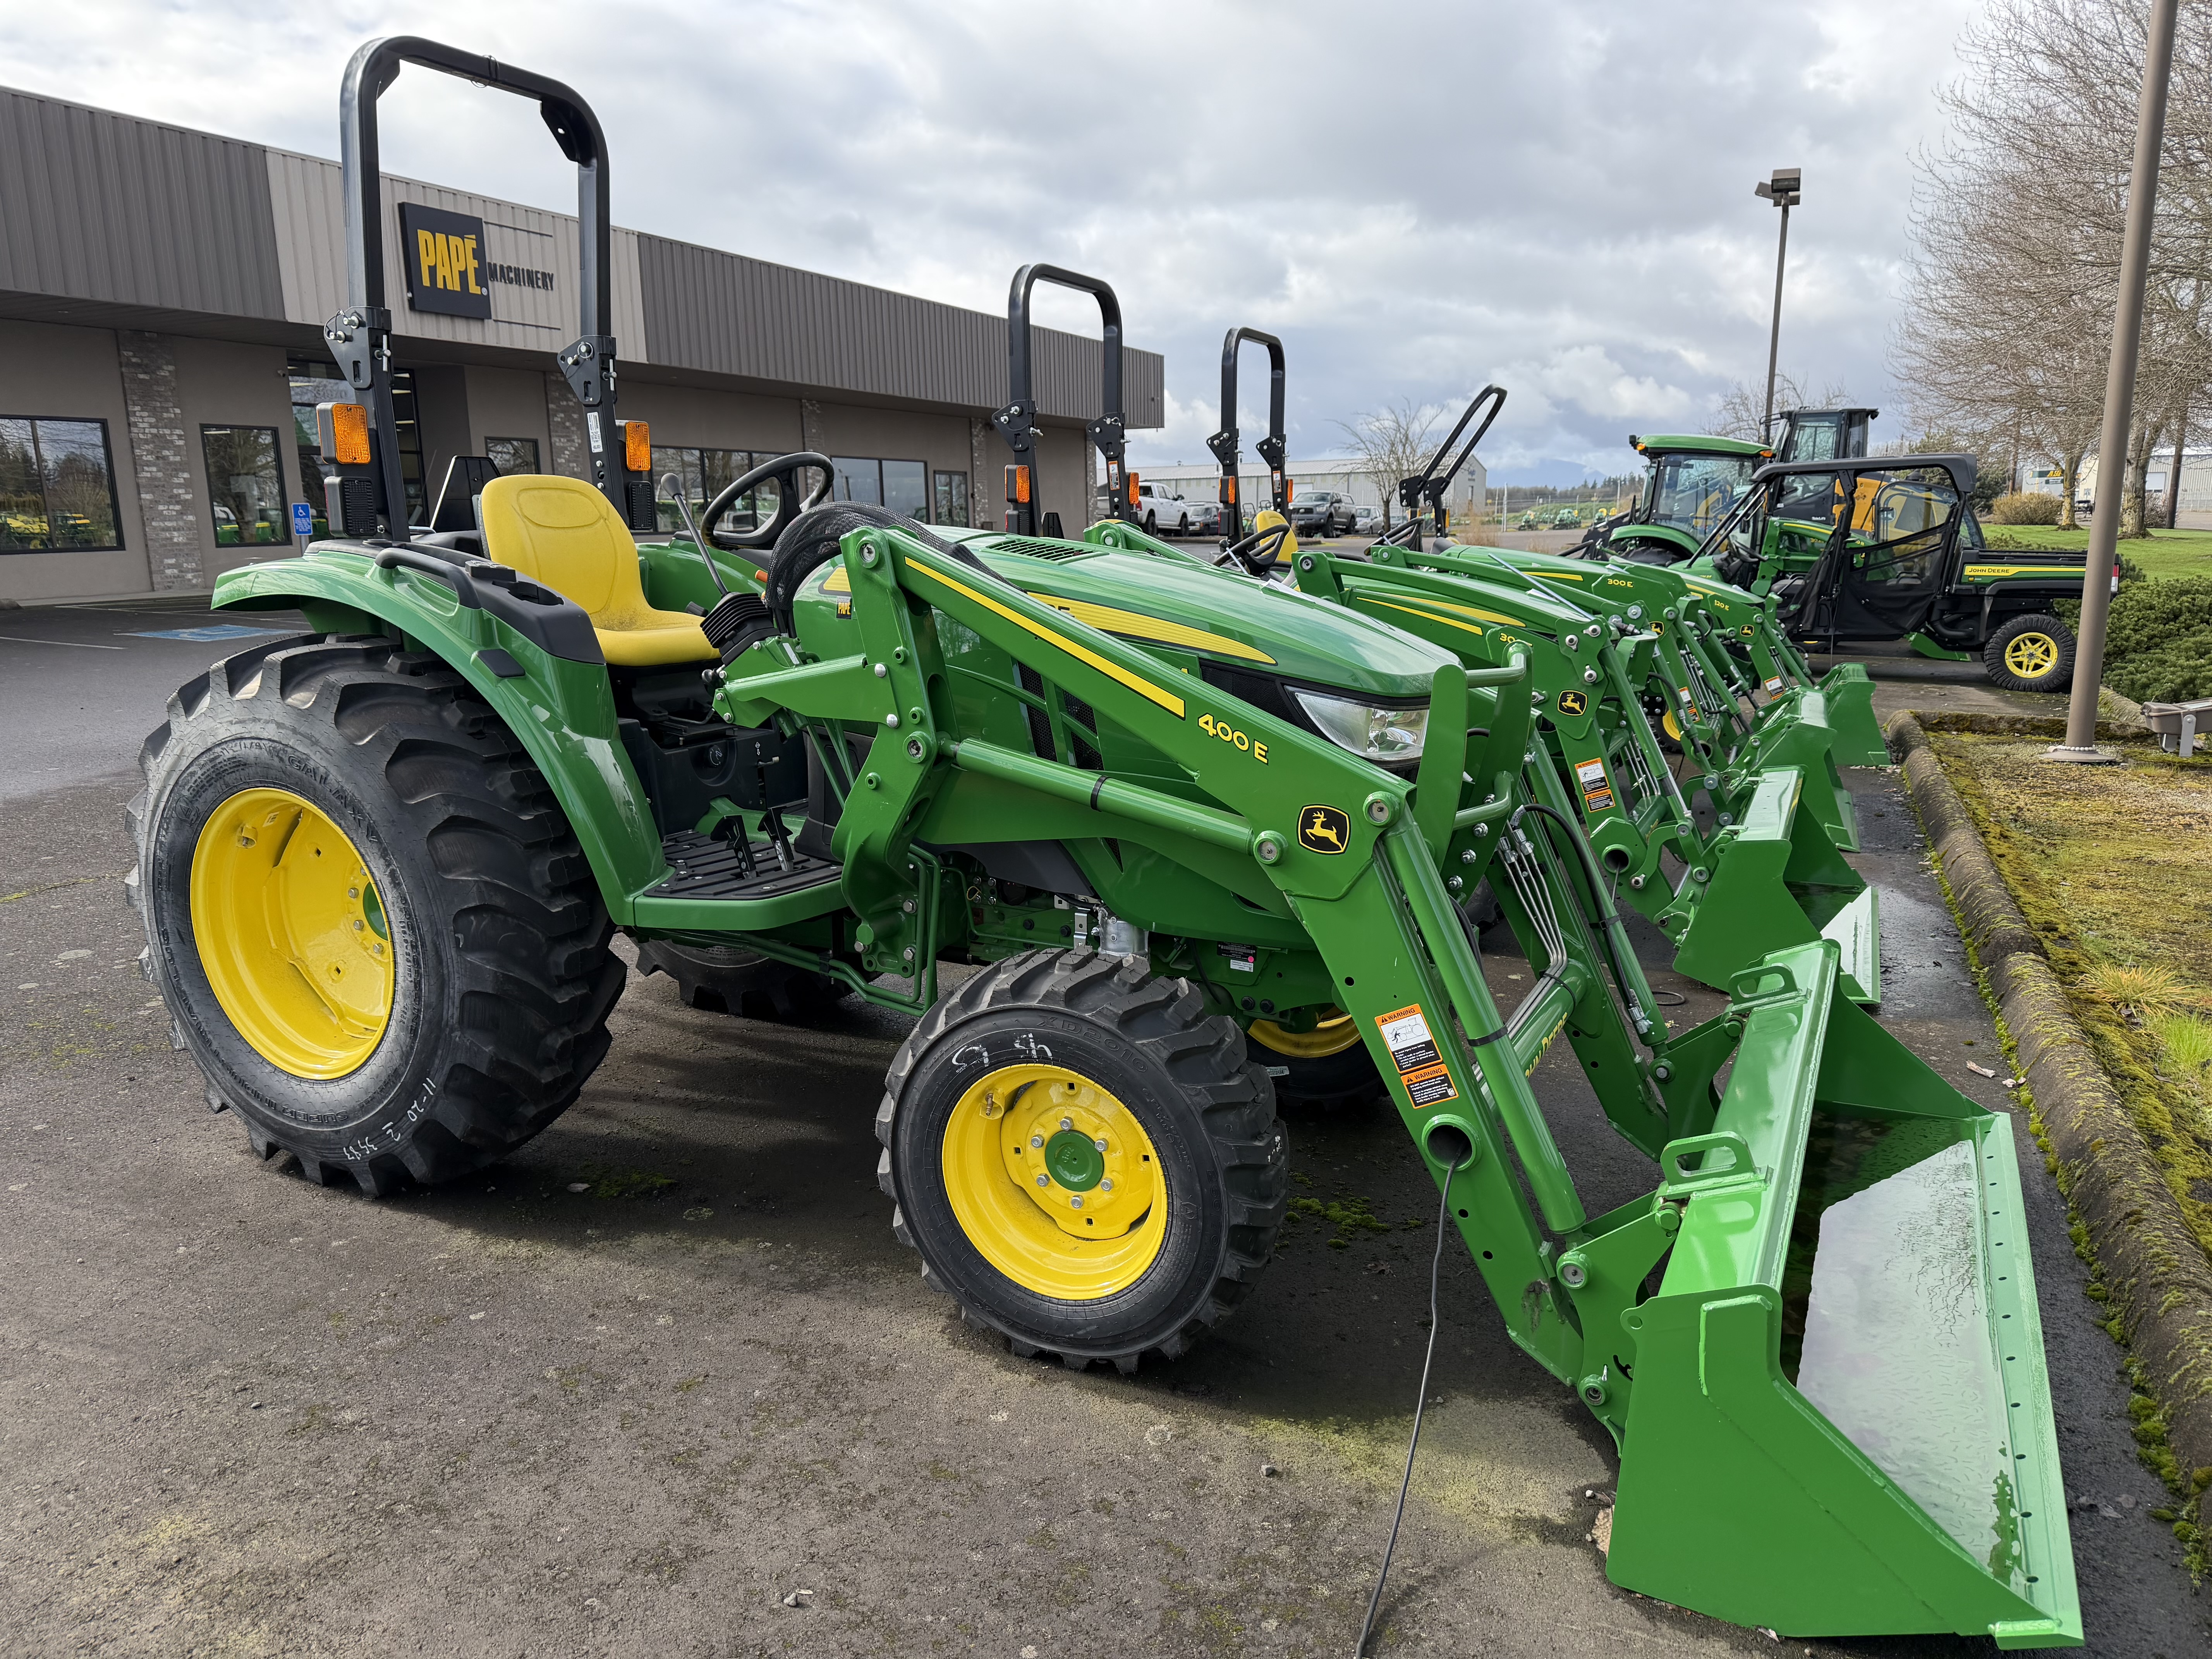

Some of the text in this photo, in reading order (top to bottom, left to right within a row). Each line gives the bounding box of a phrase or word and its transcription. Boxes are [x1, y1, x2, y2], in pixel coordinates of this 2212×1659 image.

[488, 262, 554, 290] MACHINERY
[1714, 600, 1724, 608] 120
[1198, 713, 1269, 764] 400 E
[287, 752, 381, 849] GALAXY
[1388, 1008, 1415, 1020] WARNING
[921, 1030, 969, 1076] TUBELESS
[1035, 1014, 1151, 1075] XD2010
[1414, 1068, 1442, 1080] WARNING
[282, 1102, 349, 1125] SUPER
[1170, 1126, 1193, 1172] RATING
